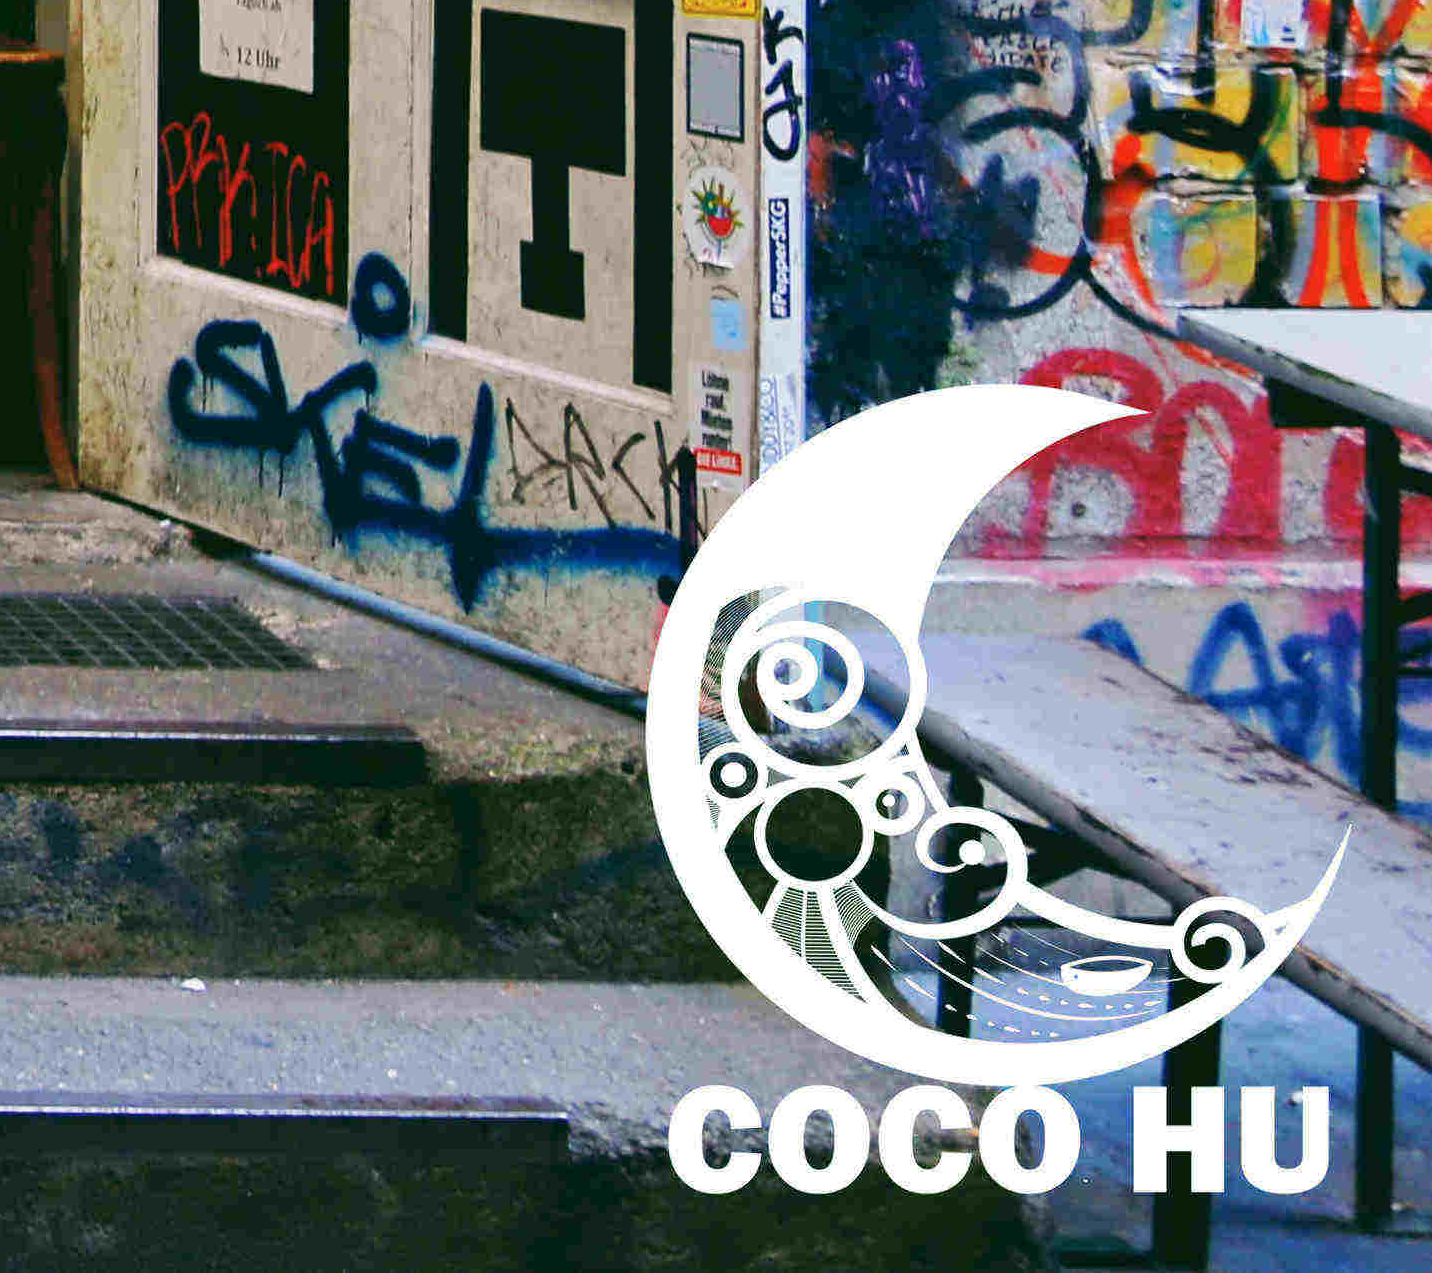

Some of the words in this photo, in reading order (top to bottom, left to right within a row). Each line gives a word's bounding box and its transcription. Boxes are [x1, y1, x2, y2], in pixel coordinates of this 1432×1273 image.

[236, 45, 254, 66] 12
[255, 47, 282, 71] Uhr
[769, 199, 790, 319] #PepperSKG
